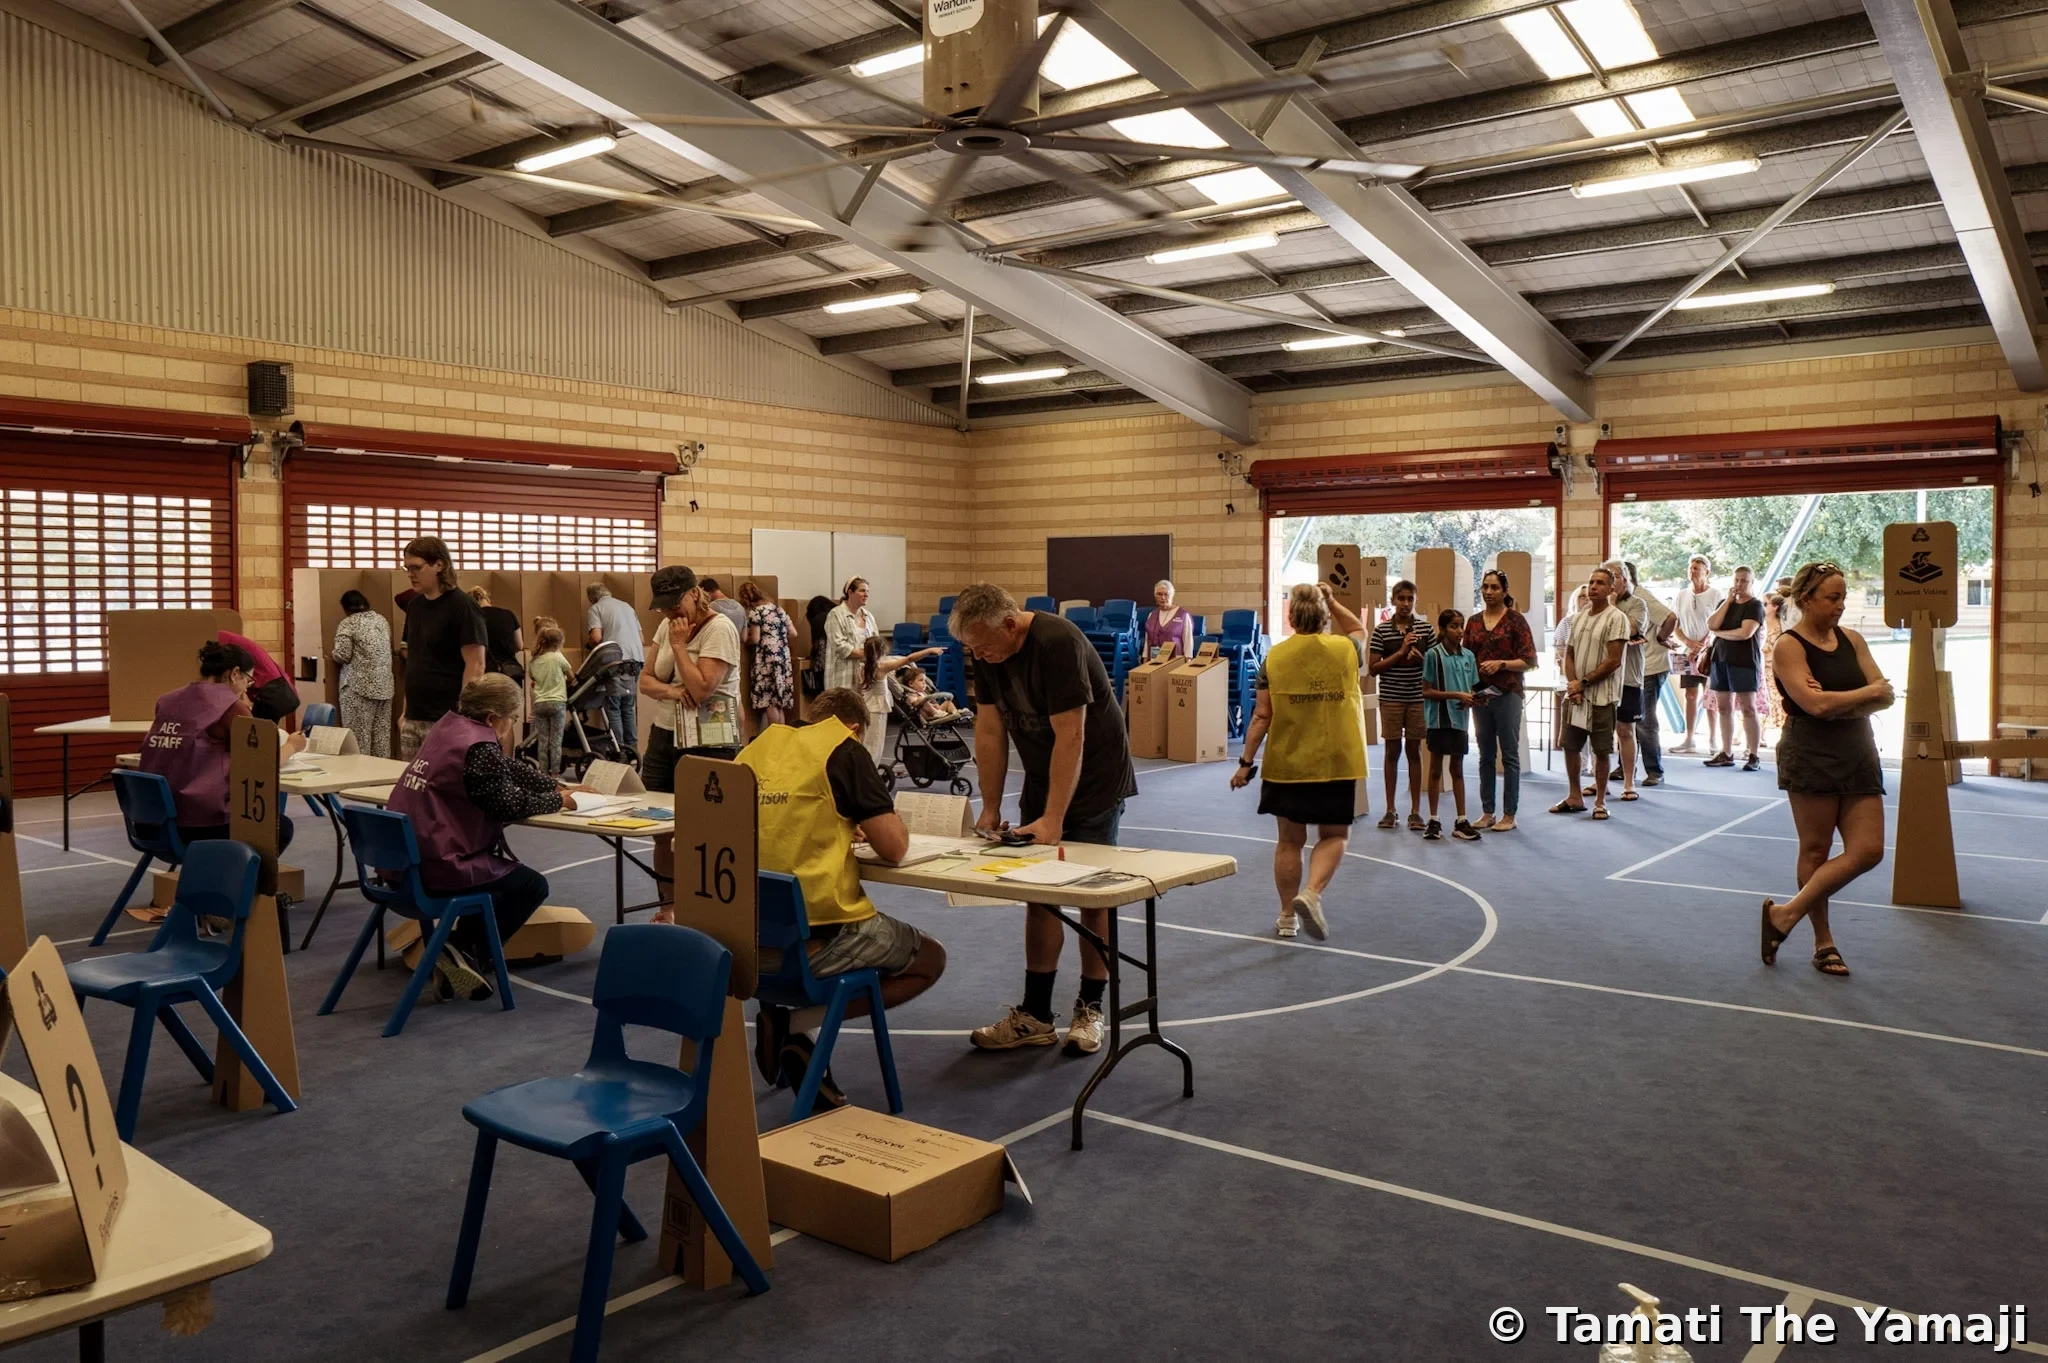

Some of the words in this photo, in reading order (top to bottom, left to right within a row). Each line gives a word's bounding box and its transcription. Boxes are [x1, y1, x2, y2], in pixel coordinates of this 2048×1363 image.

[1366, 577, 1381, 586] Exit
[1923, 588, 1948, 596] Voting
[1172, 678, 1192, 687] BALLOT
[1310, 680, 1325, 690] AEC
[1176, 686, 1188, 694] BOX
[1289, 690, 1345, 704] SUPERVISOR
[159, 722, 181, 735] AEC
[149, 735, 182, 749] STAFF
[241, 778, 265, 823] 15
[694, 842, 736, 904] 16
